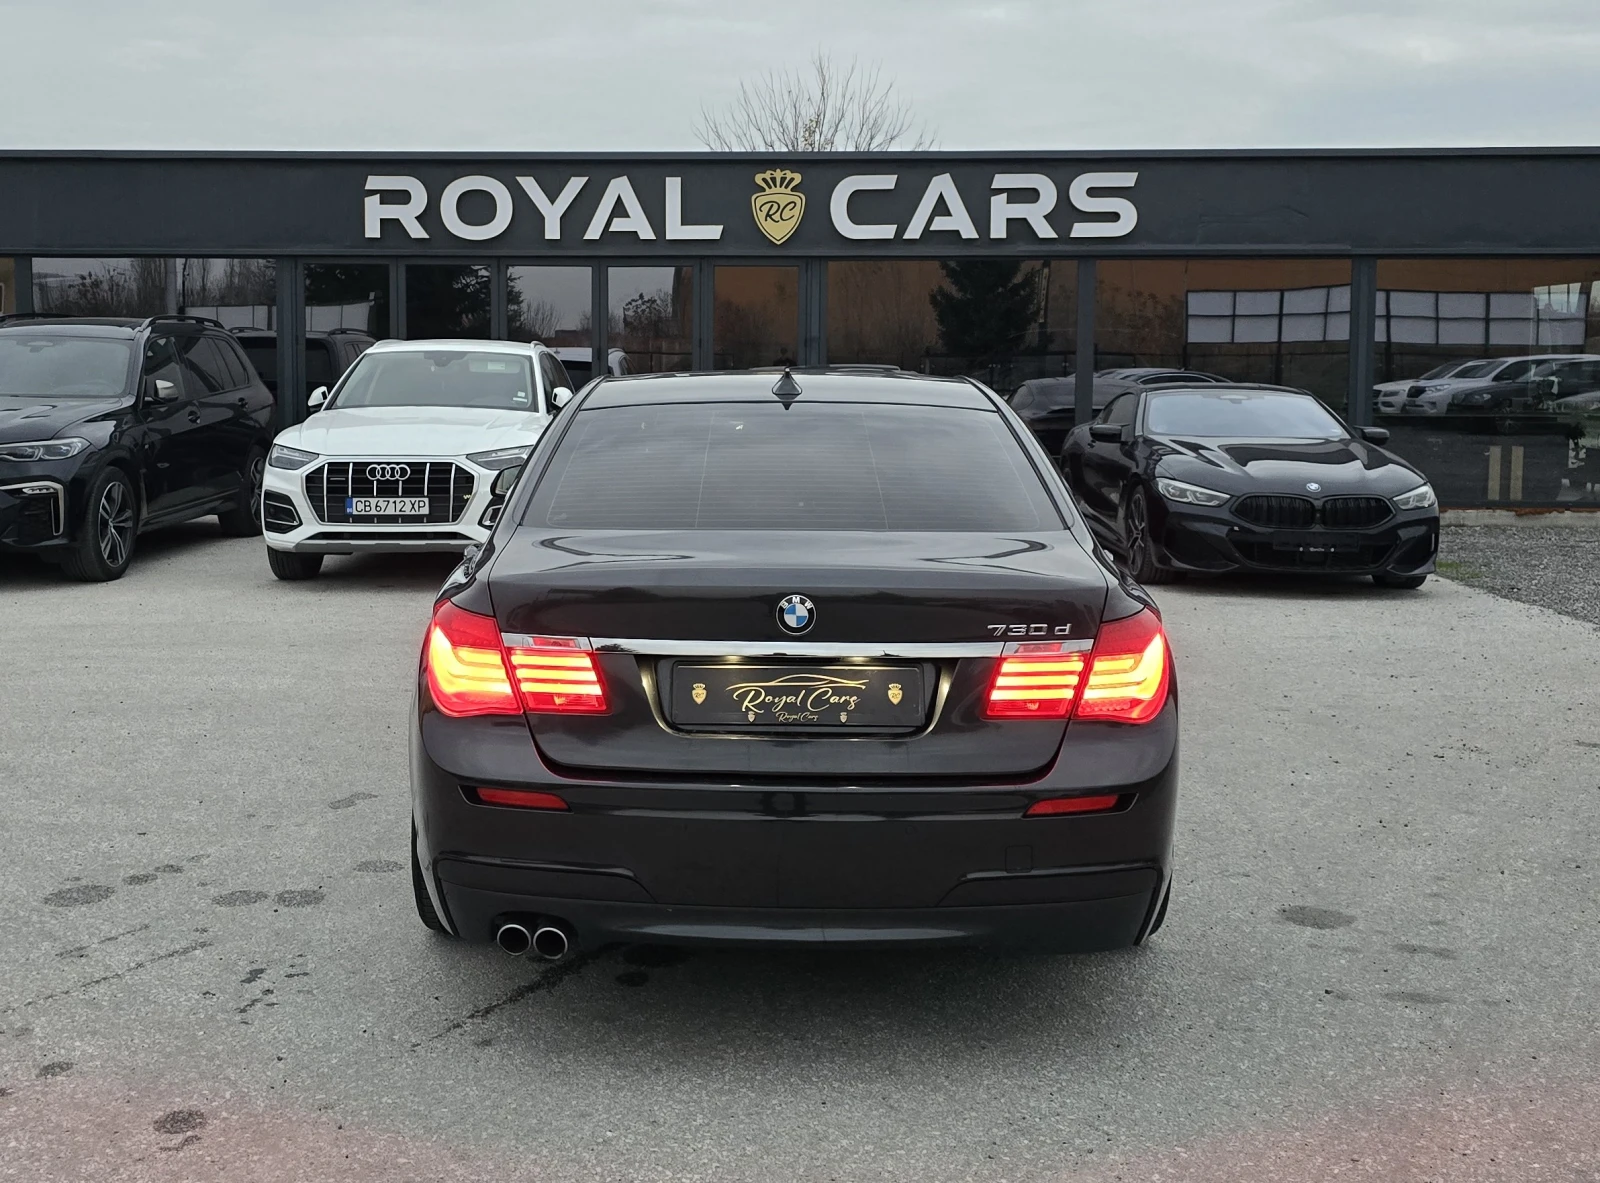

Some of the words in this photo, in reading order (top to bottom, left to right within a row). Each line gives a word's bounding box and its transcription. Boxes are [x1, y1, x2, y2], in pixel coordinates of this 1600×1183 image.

[364, 175, 724, 241] ROYAL
[829, 172, 1139, 240] CARS
[758, 200, 797, 223] RC
[355, 500, 372, 513] CB
[375, 500, 406, 513] 6712
[409, 500, 426, 513] XP
[987, 624, 1048, 636] 730
[1054, 623, 1072, 635] d
[732, 687, 806, 713] Royal
[807, 687, 861, 711] Cars
